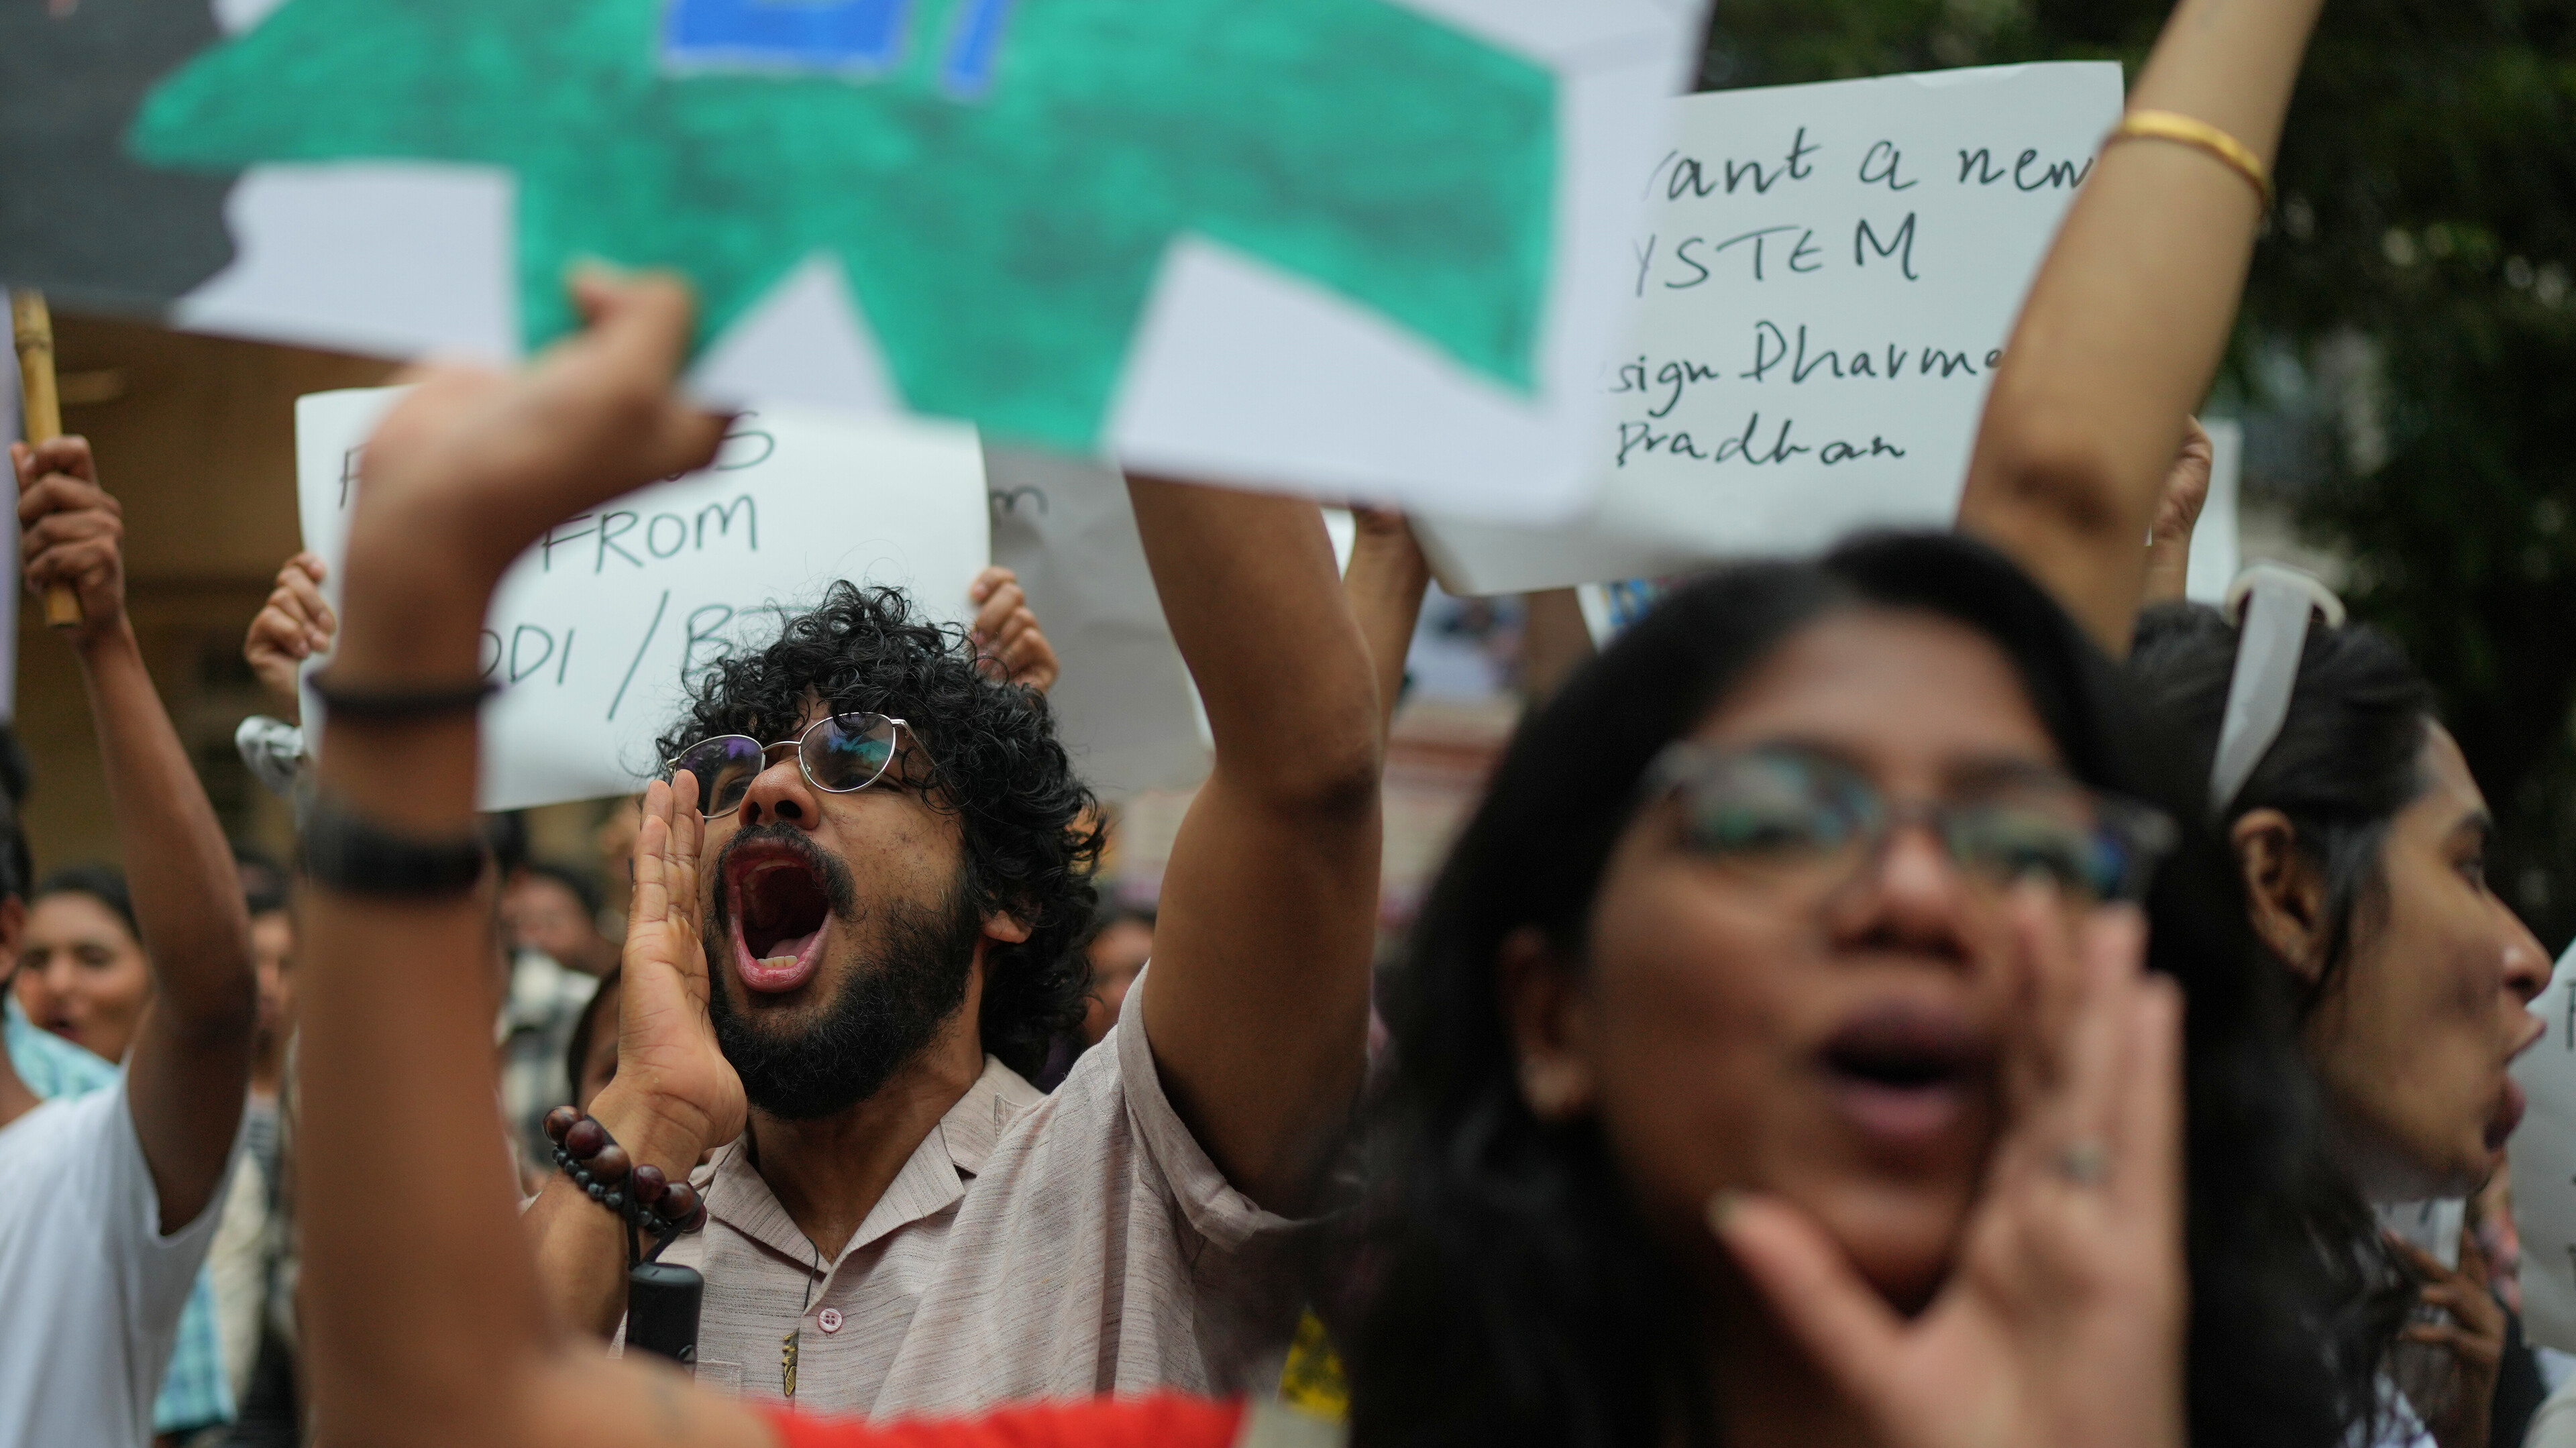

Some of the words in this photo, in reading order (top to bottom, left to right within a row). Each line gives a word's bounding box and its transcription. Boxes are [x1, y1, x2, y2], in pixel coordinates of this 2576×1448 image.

[1645, 126, 1822, 201] ant
[1859, 139, 1919, 191] a
[1957, 147, 2094, 192] new
[1631, 211, 1919, 297] YSTEM
[1605, 353, 1719, 419] sign
[1739, 319, 2004, 385] Dharme
[1617, 411, 1906, 467] Pradhan
[541, 494, 757, 574] FROM
[480, 624, 577, 685] ODI
